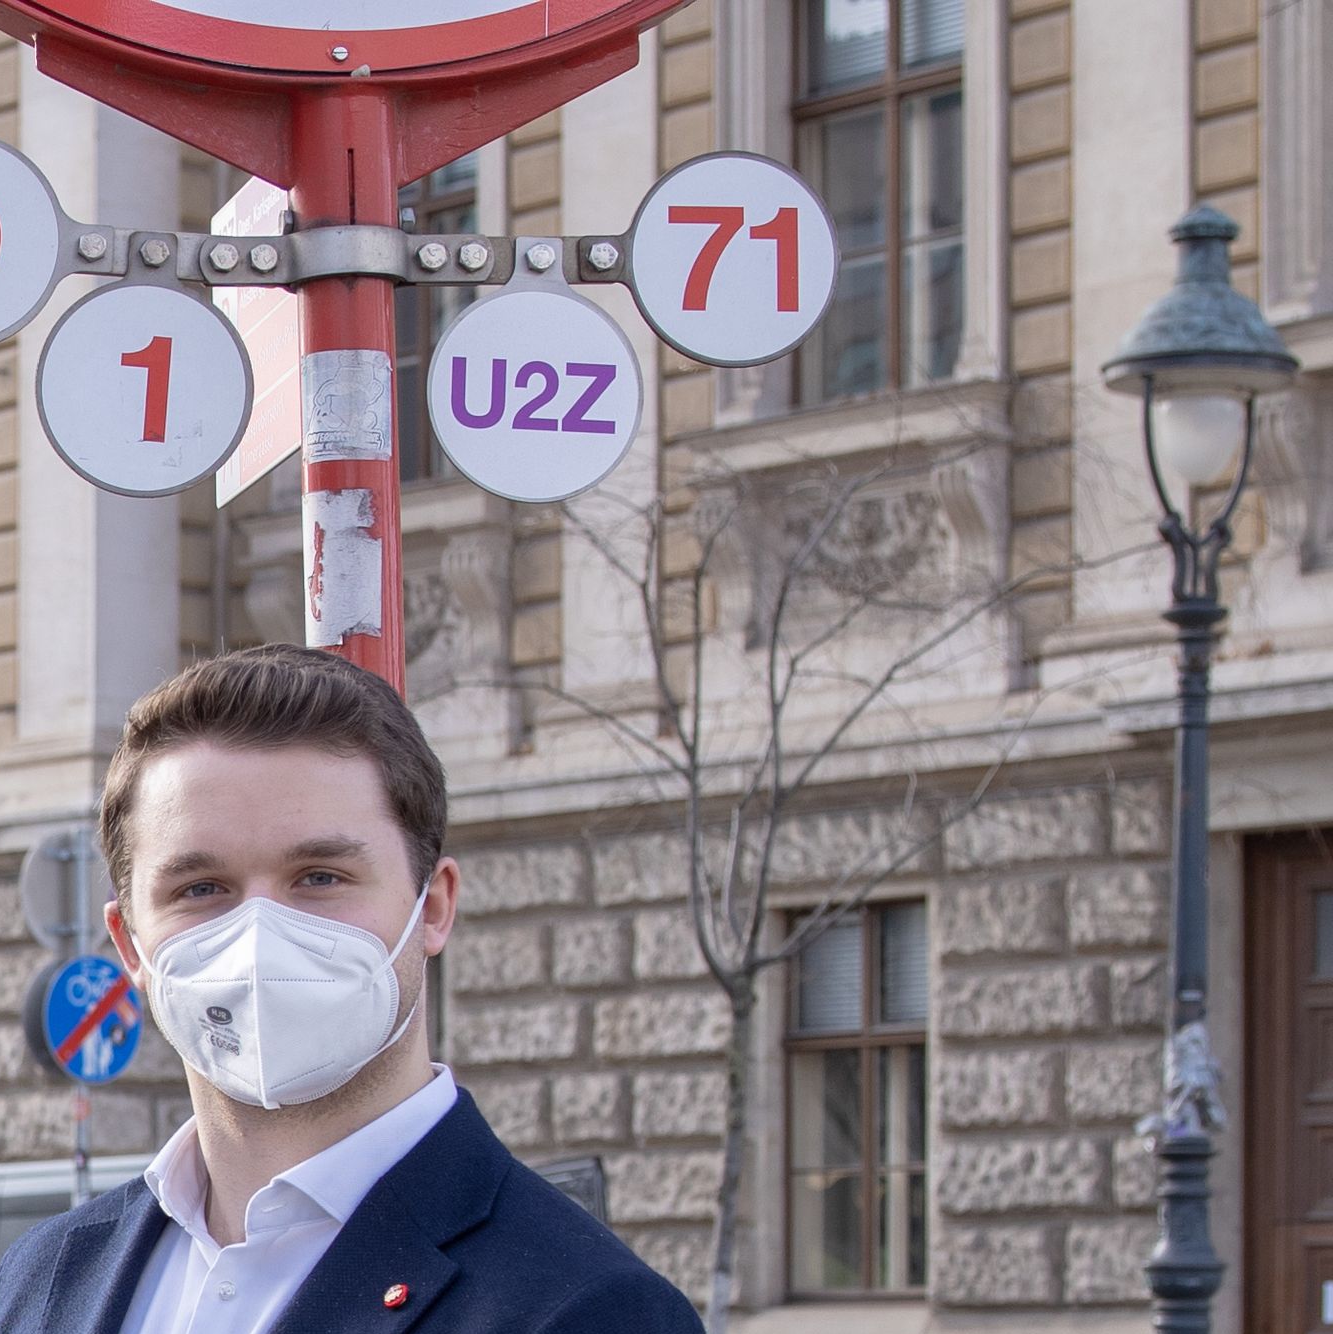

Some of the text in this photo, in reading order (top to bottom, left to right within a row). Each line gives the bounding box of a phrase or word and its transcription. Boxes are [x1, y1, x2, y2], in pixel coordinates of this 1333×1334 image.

[668, 206, 799, 312] 71
[121, 336, 172, 443] 1
[451, 356, 616, 434] U2Z
